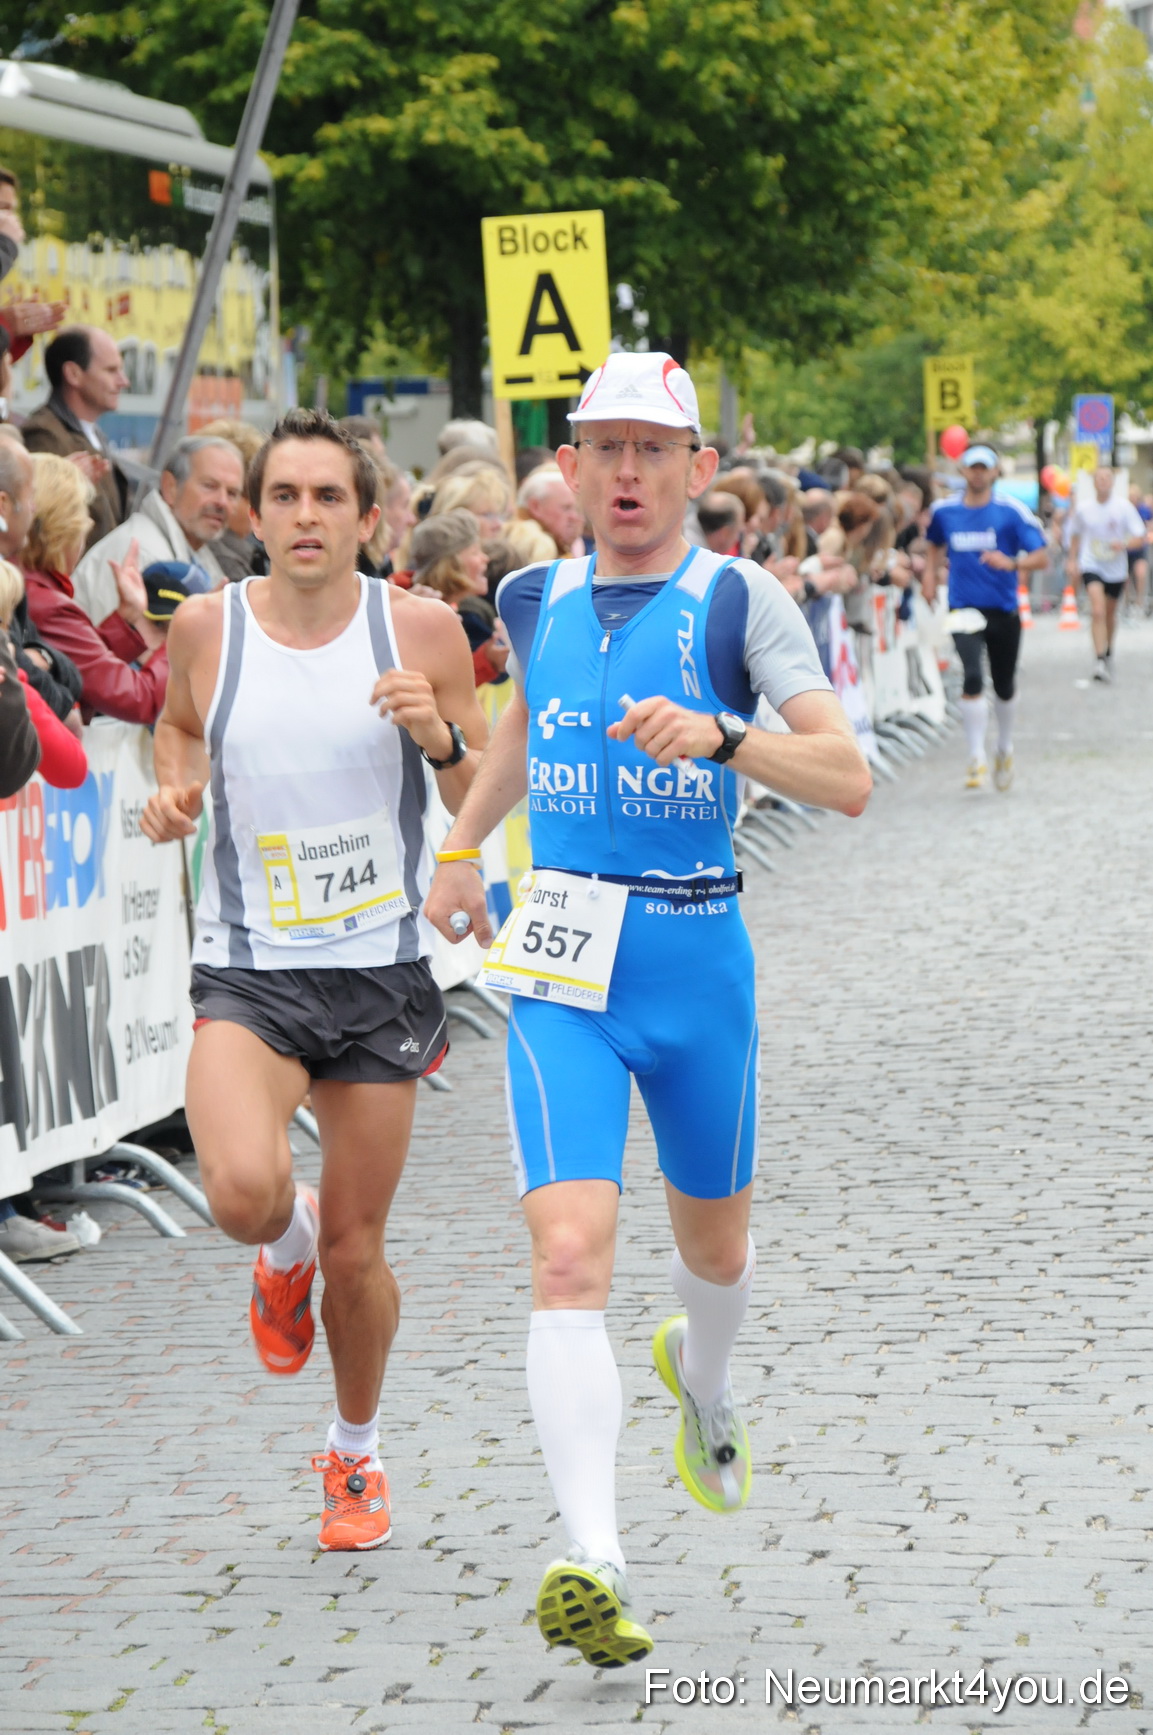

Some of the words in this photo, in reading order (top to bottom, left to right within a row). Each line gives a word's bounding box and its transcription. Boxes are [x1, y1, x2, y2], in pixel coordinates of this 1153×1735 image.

[498, 219, 589, 256] Block
[518, 269, 583, 357] A
[940, 378, 962, 411] B
[677, 608, 703, 700] 2XU
[297, 833, 371, 861] Joachim
[273, 875, 282, 890] A
[314, 858, 378, 903] 744
[356, 896, 406, 922] PFLEIDERER
[522, 919, 593, 964] 557
[551, 982, 605, 1003] PFLEIDERER
